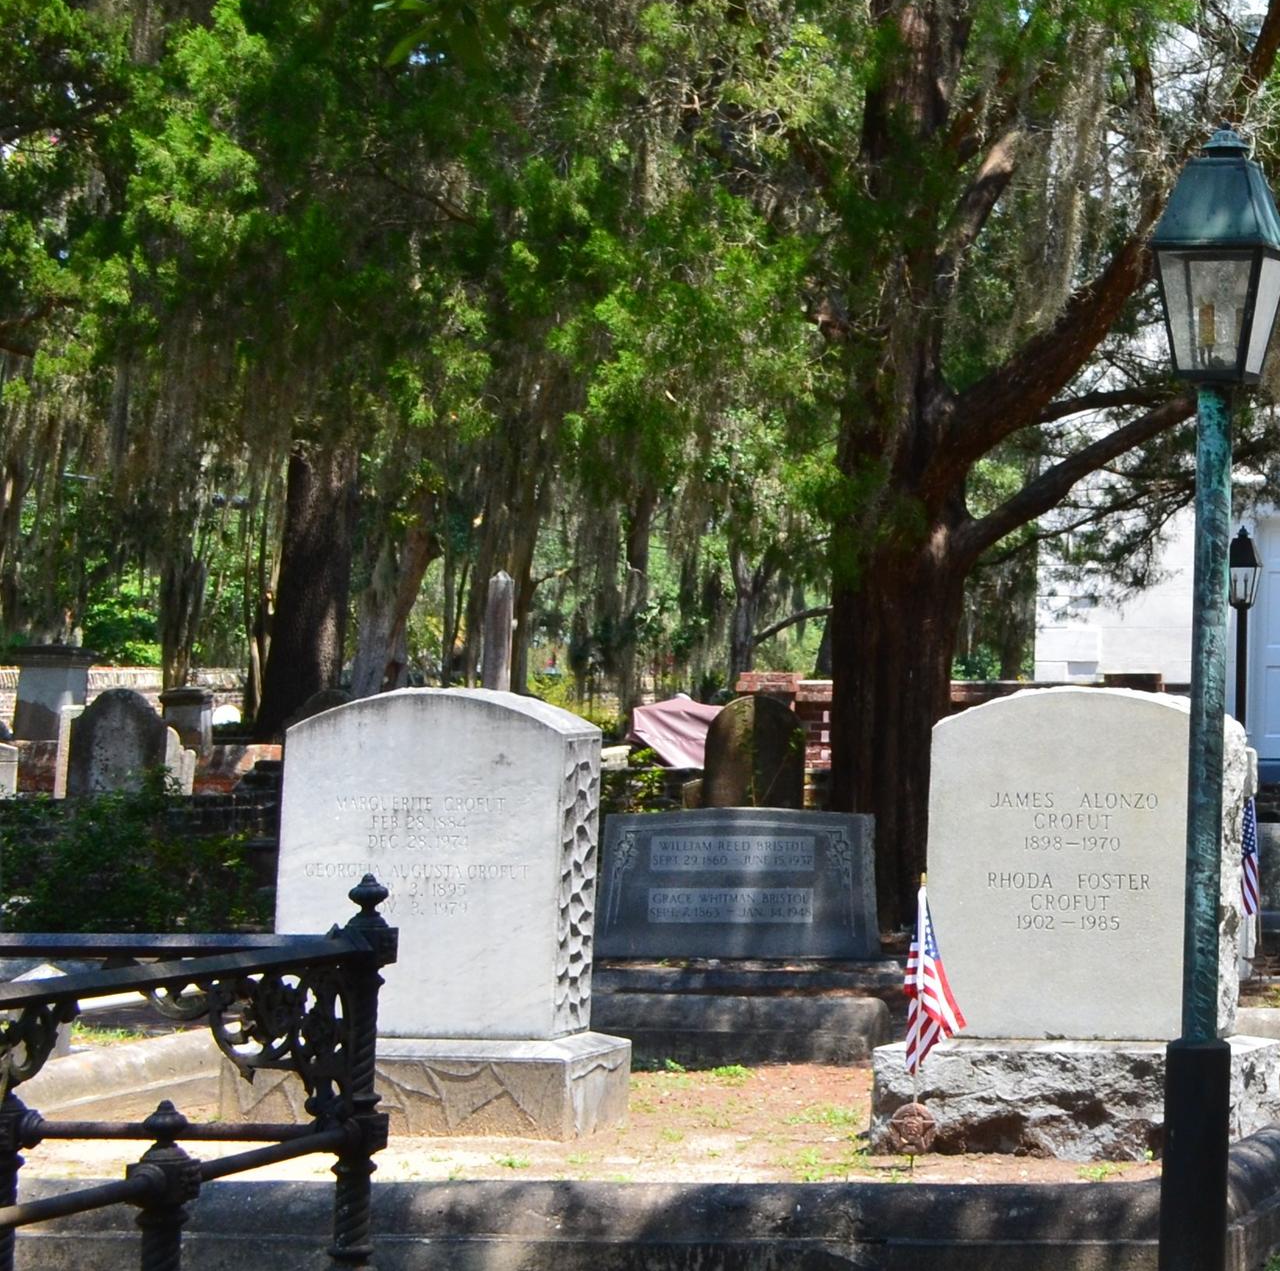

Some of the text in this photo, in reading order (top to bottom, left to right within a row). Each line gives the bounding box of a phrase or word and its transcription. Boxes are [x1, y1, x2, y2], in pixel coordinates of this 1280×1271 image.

[336, 796, 506, 811] MARGUERITE CROFUT
[990, 792, 1158, 809] JAMES ALONZO
[1034, 813, 1112, 829] CROFUT
[659, 840, 807, 852] WILLIAM REED BRISTOL
[391, 864, 463, 878] AUGUSTA
[467, 864, 529, 878] CROFUT
[988, 872, 1151, 890] RHODA FOSTER
[652, 893, 808, 905] GRACE WHITMAN BRISTOL
[1031, 894, 1111, 911] CROFUT
